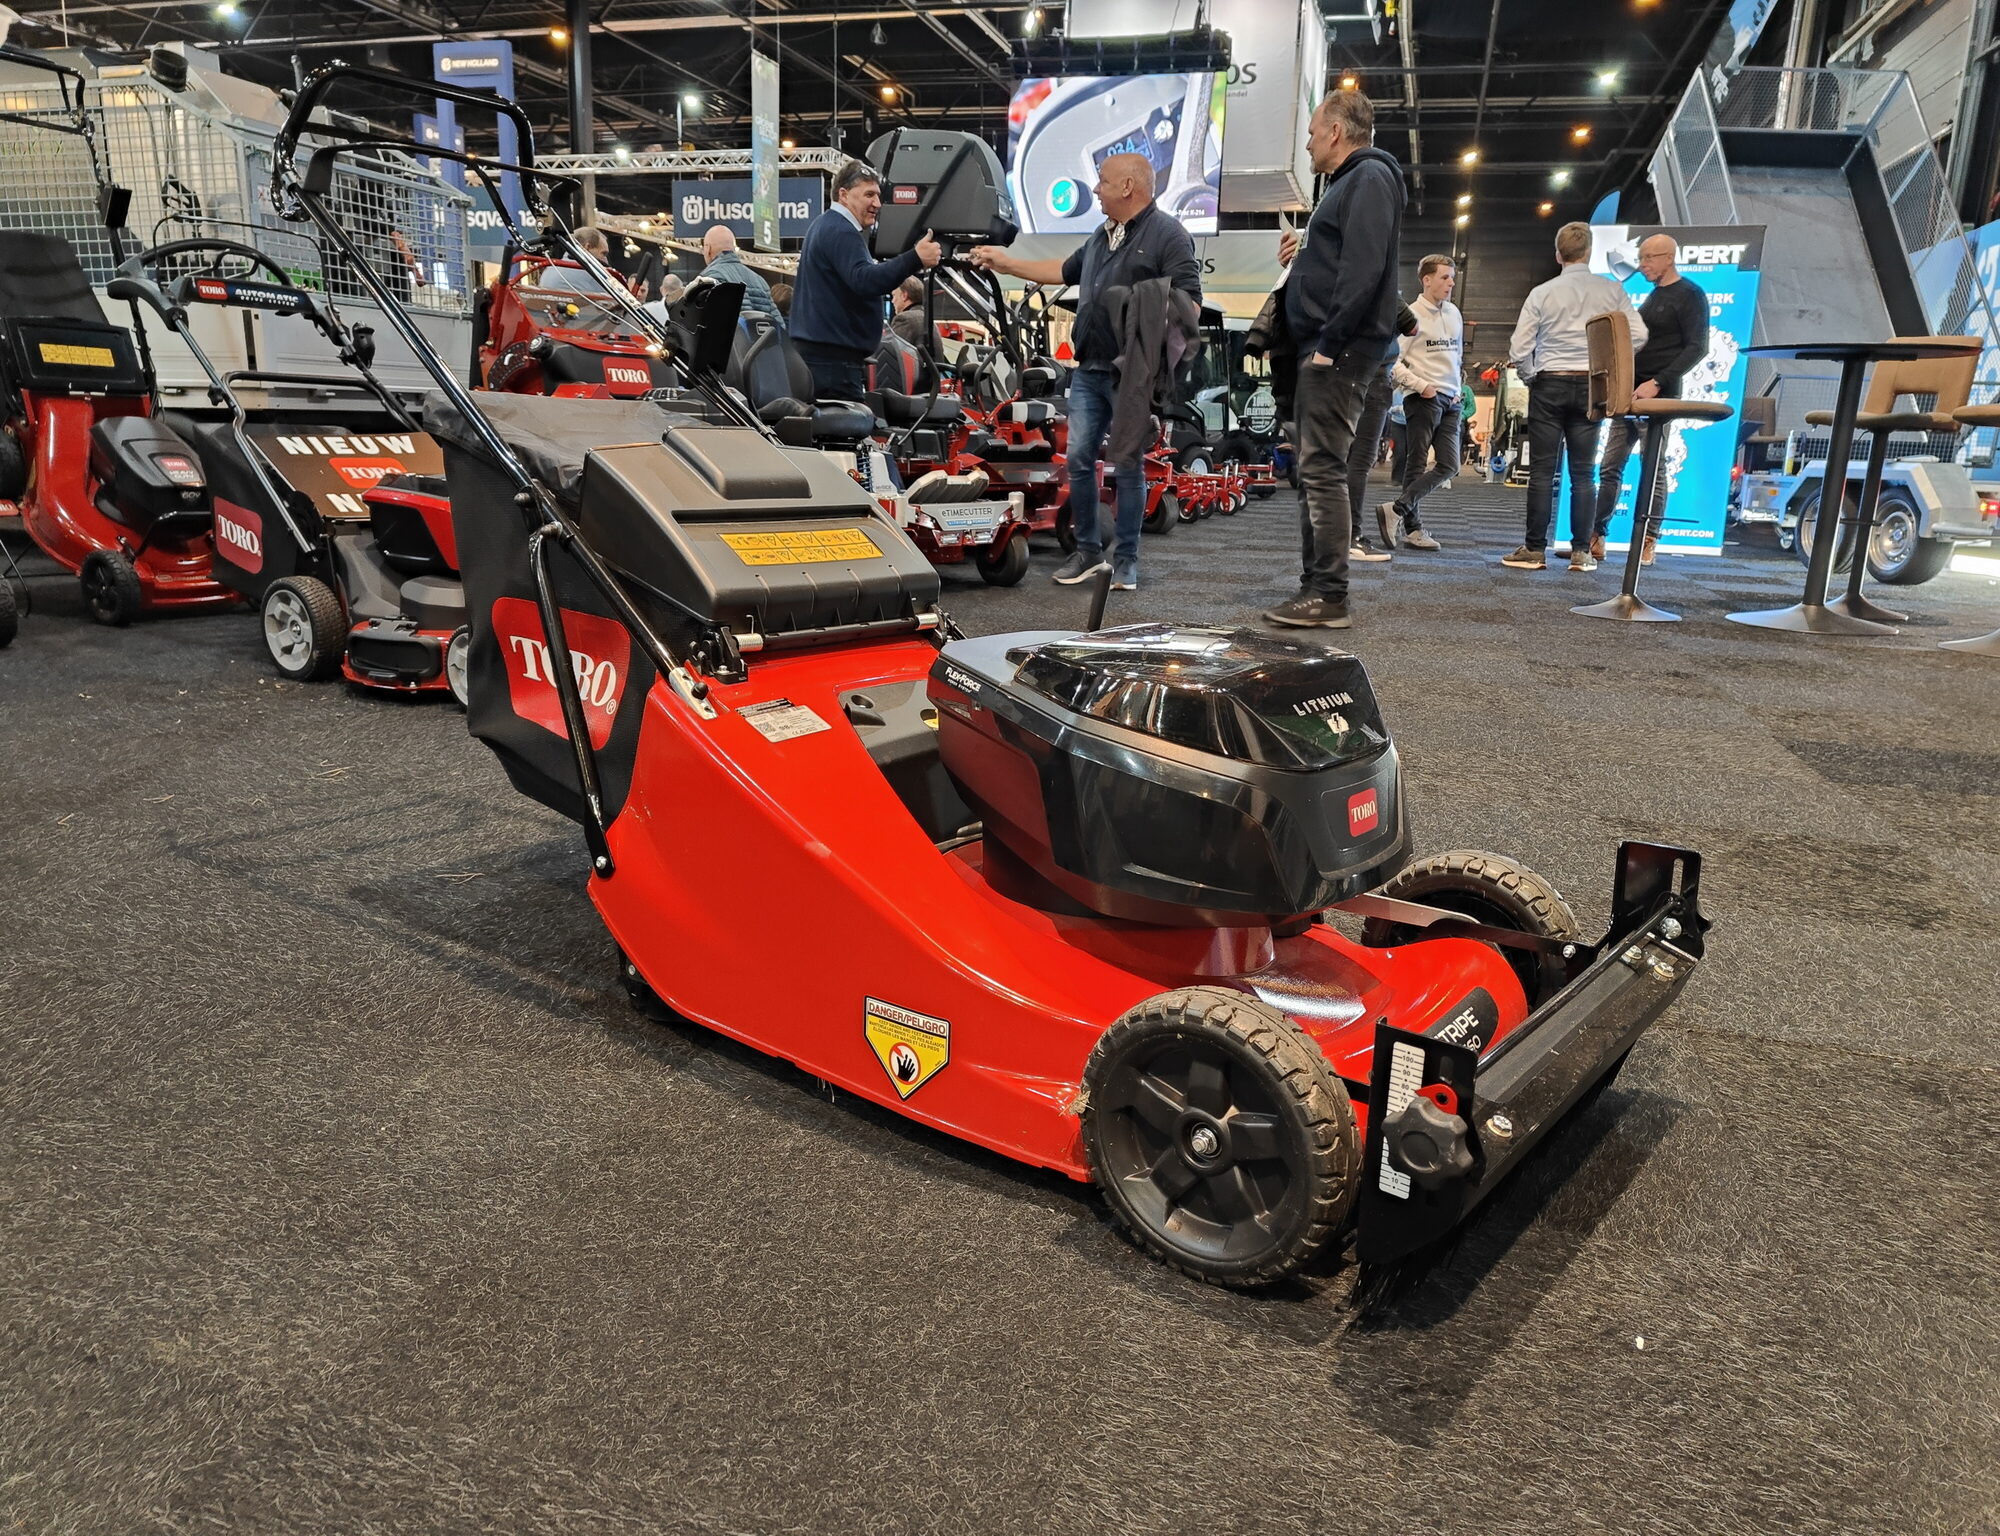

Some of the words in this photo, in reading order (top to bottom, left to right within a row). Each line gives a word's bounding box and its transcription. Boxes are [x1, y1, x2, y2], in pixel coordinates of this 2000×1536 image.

[451, 60, 466, 68] NEW
[467, 58, 499, 68] HOLLAND
[894, 190, 917, 199] TORO
[763, 220, 772, 245] 5
[200, 285, 226, 295] TORO
[235, 287, 299, 303] AUTOMATIC
[607, 367, 650, 384] TORO
[277, 435, 416, 455] NIEUW
[941, 507, 993, 517] eTIMECUTTER
[217, 513, 261, 556] TORO
[1292, 691, 1354, 716] LITHIUM
[1351, 799, 1377, 823] TORO
[868, 1002, 947, 1035] DANGER/PELIGRO
[1433, 1010, 1479, 1045] TRIPE
[1402, 1055, 1415, 1064] 100
[1402, 1069, 1411, 1077] 90
[1401, 1083, 1410, 1091] 80
[1391, 1177, 1399, 1185] 10
